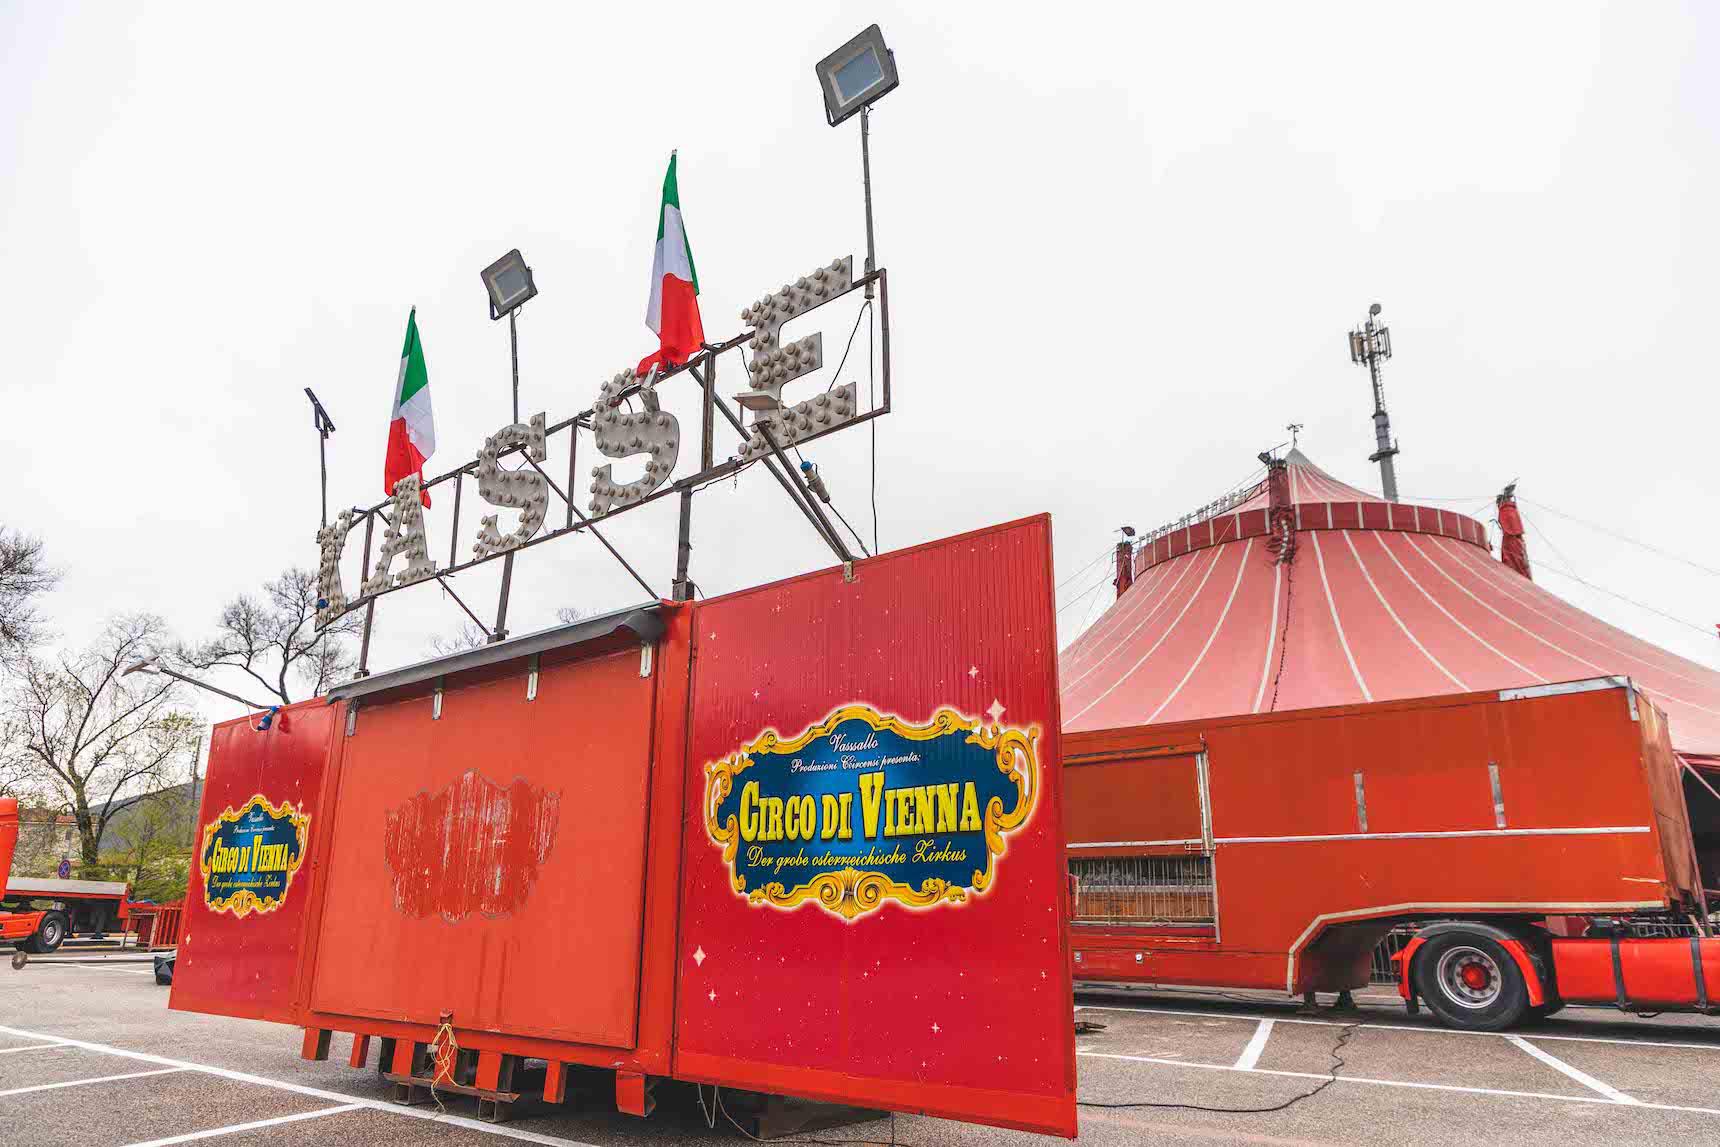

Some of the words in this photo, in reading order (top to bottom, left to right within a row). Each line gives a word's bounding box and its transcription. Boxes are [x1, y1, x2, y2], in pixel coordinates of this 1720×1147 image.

[315, 254, 856, 632] KASSE
[739, 780, 816, 843] CIRCO
[820, 793, 853, 841] DI
[858, 772, 983, 839] VIENNA
[212, 837, 239, 873] CIRCO
[238, 846, 251, 873] DI
[251, 834, 289, 873] VIENNA
[746, 845, 773, 867] Der
[911, 839, 967, 863] Zirkus
